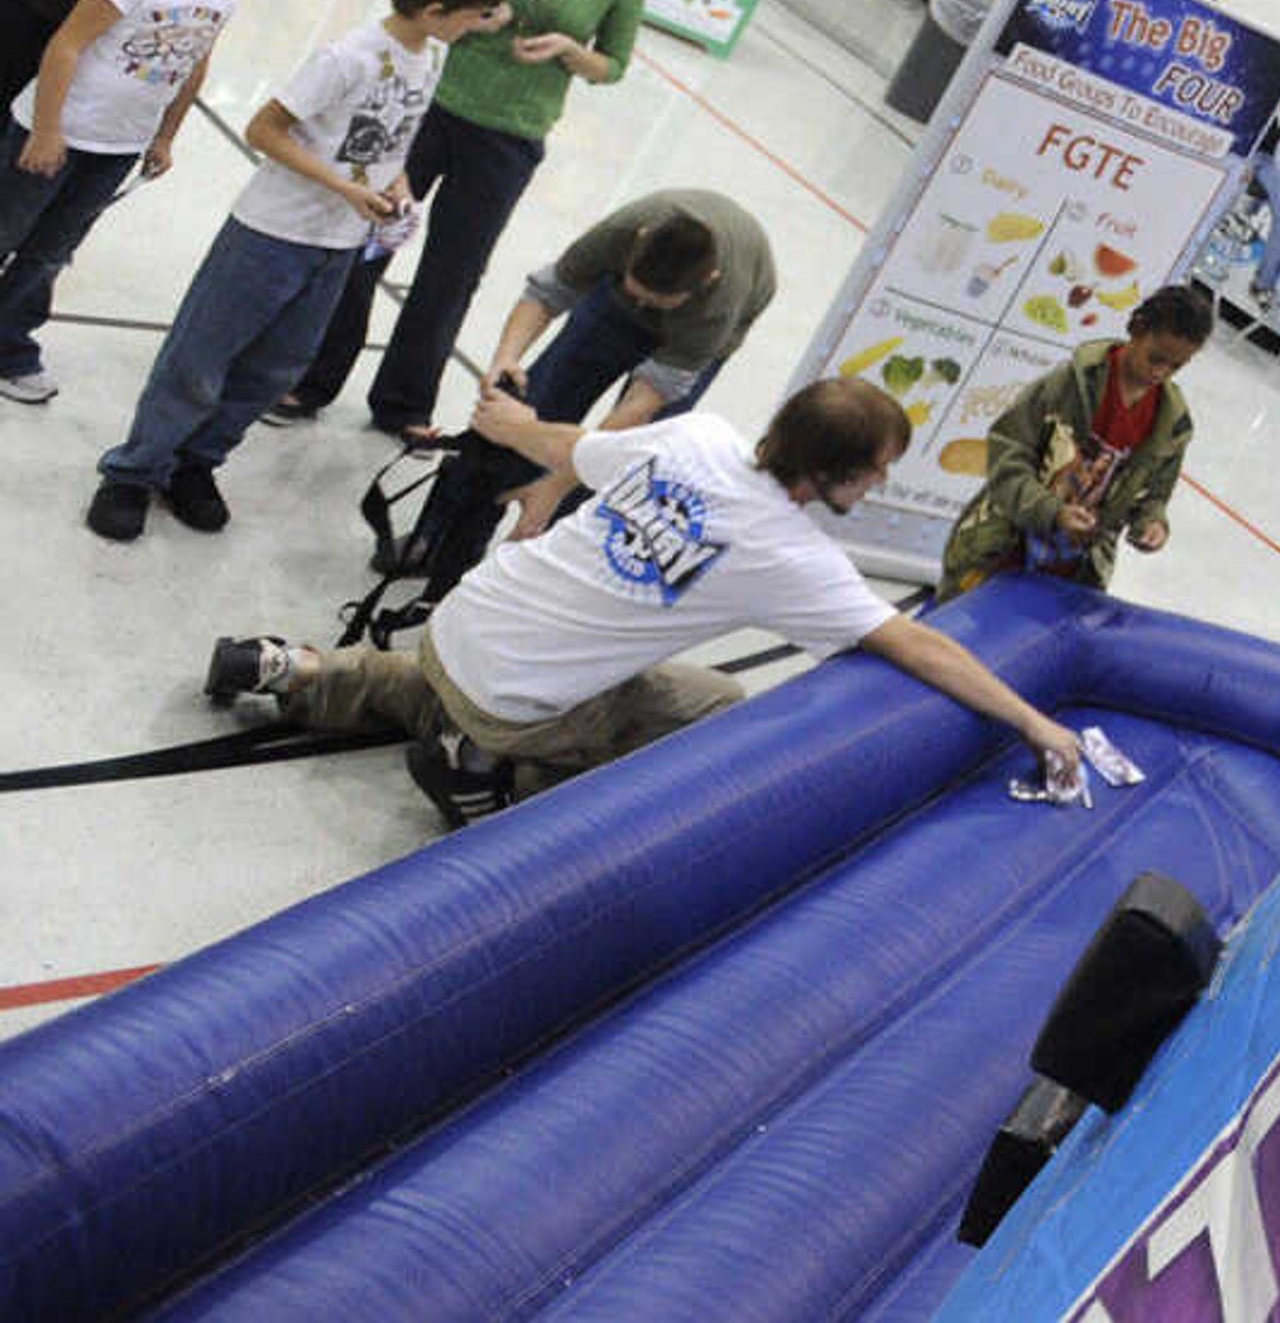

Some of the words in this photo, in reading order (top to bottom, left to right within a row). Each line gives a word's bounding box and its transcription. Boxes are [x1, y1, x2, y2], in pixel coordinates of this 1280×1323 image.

[1177, 16, 1231, 71] Big
[1013, 49, 1058, 82] Food
[1058, 70, 1116, 112] Groups
[1119, 93, 1141, 119] To
[1154, 64, 1244, 123] FOUR
[980, 167, 1031, 203] Dairy
[1035, 124, 1146, 191] FGTE
[1094, 210, 1140, 240] Fruit
